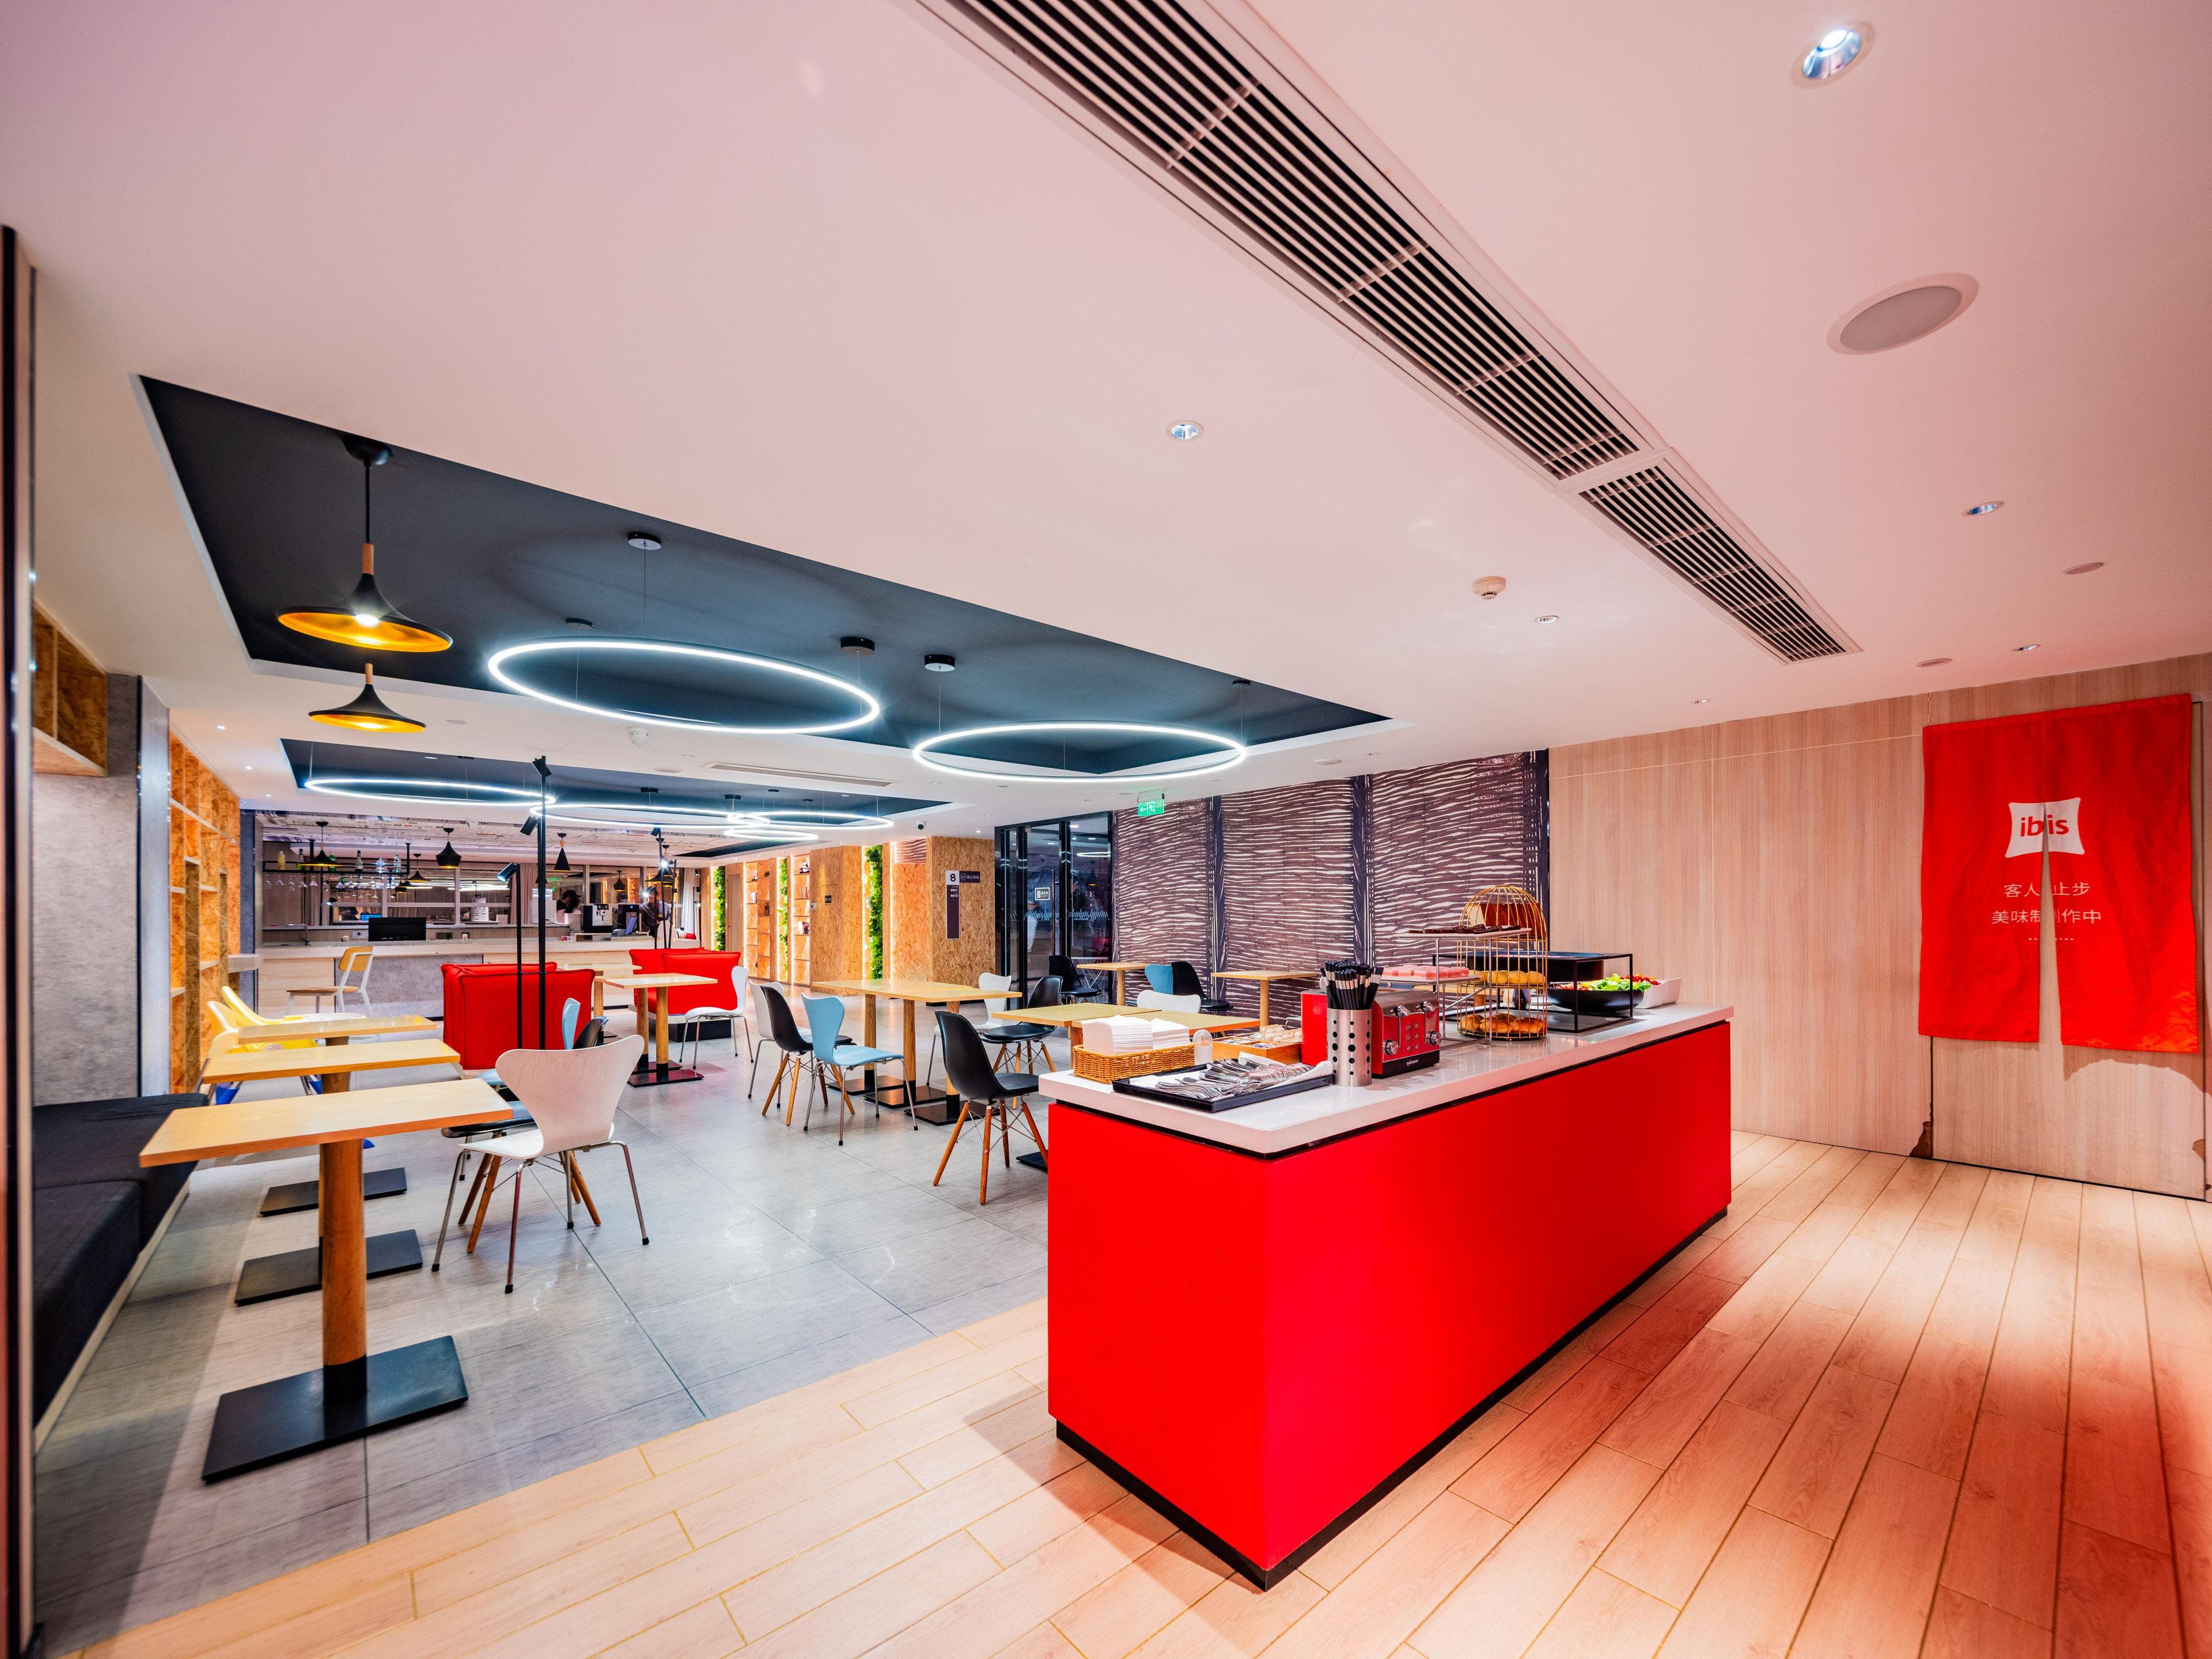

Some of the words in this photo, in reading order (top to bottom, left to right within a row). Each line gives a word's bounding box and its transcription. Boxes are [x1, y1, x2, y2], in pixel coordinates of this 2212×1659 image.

[2020, 814, 2069, 837] ibis
[950, 873, 956, 882] 8
[2003, 881, 2091, 898] 客人止步
[1991, 908, 2102, 925] 美味制作中
